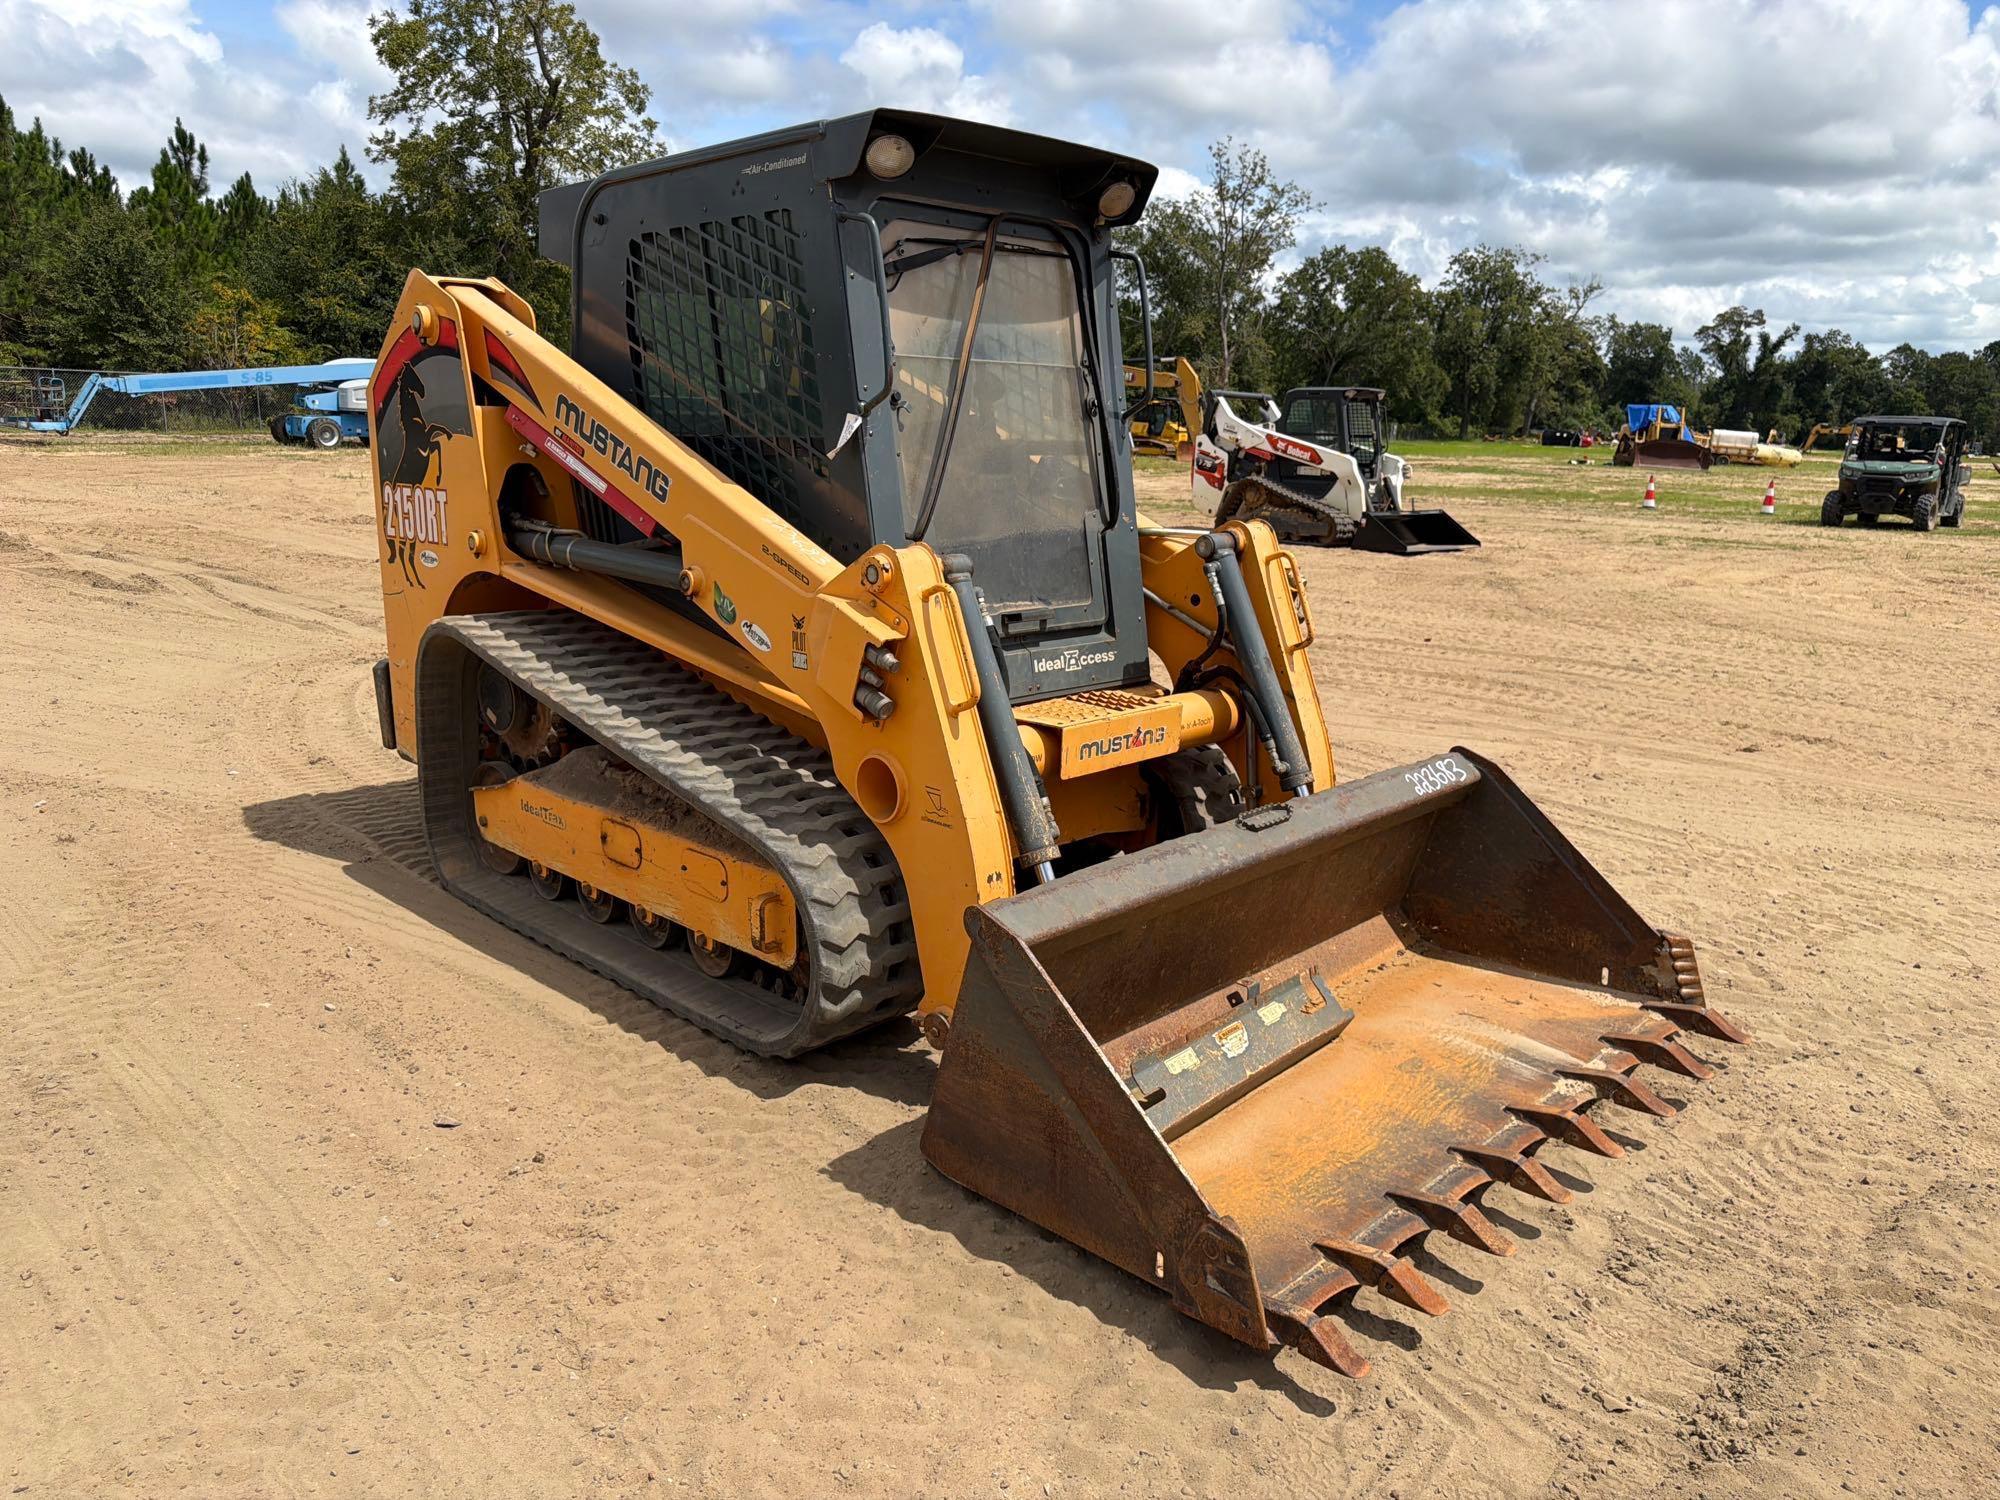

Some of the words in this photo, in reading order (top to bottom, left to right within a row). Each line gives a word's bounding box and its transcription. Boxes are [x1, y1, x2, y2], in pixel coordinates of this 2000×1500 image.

[750, 152, 807, 175] Air-Conditioned
[240, 371, 273, 384] S-85
[555, 393, 671, 504] MUSTANG
[1286, 444, 1312, 461] Bobcat
[384, 482, 449, 547] 2150RT
[761, 544, 810, 586] 2-SPEED
[1079, 726, 1166, 760] MUSTANG
[1404, 758, 1467, 796] 223683
